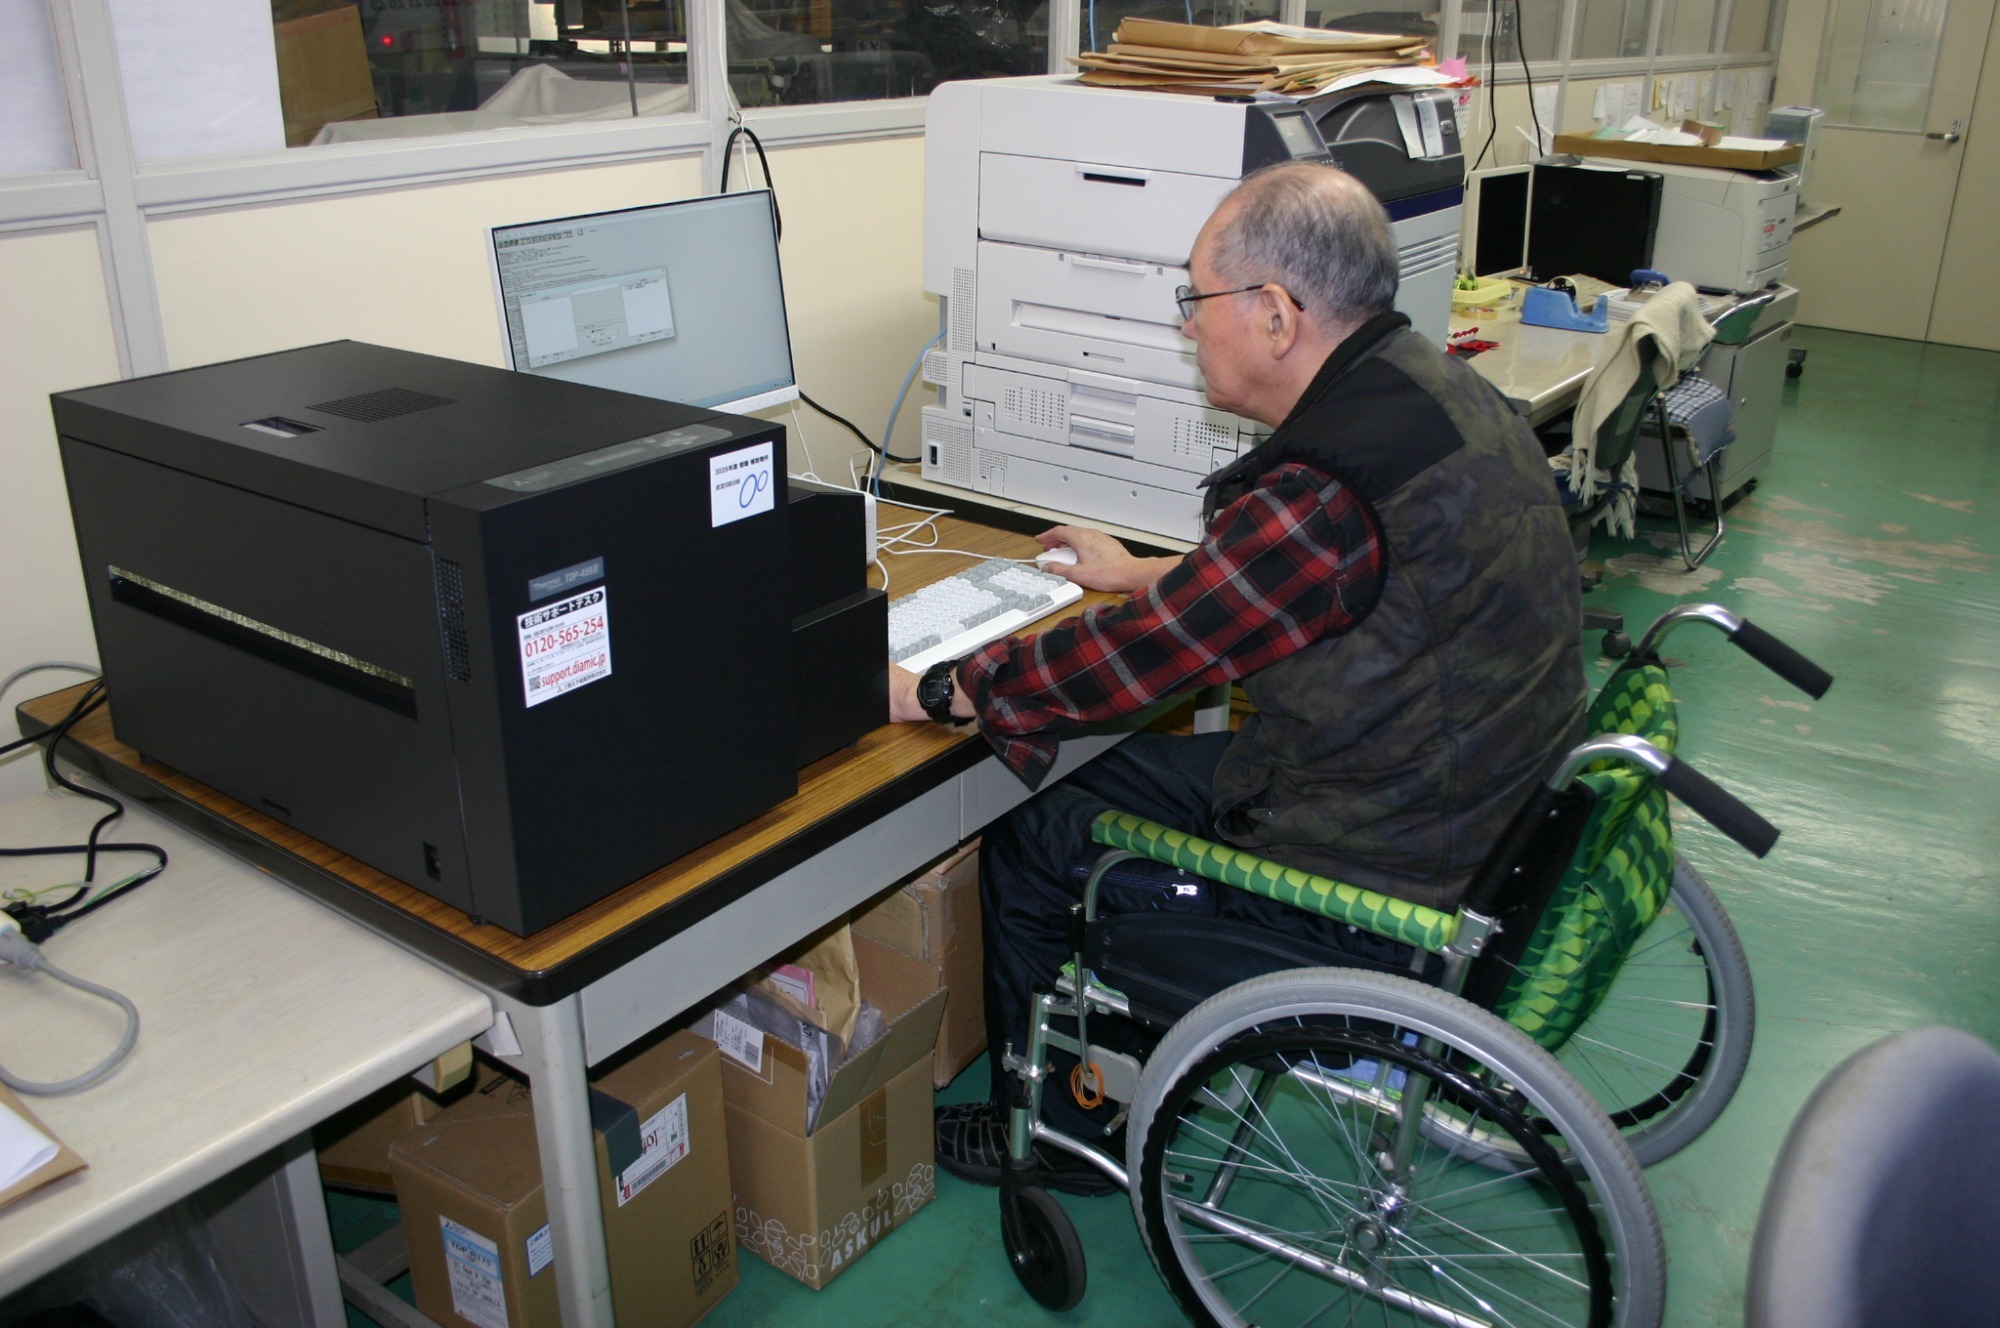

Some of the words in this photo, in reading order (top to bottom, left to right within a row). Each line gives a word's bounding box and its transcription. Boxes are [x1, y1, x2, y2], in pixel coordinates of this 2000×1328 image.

[524, 593, 600, 628] 技術サポートデスク
[525, 615, 604, 657] 0120-565-254
[541, 652, 606, 687] support.diamic.jp
[831, 1209, 892, 1271] ASKUL
